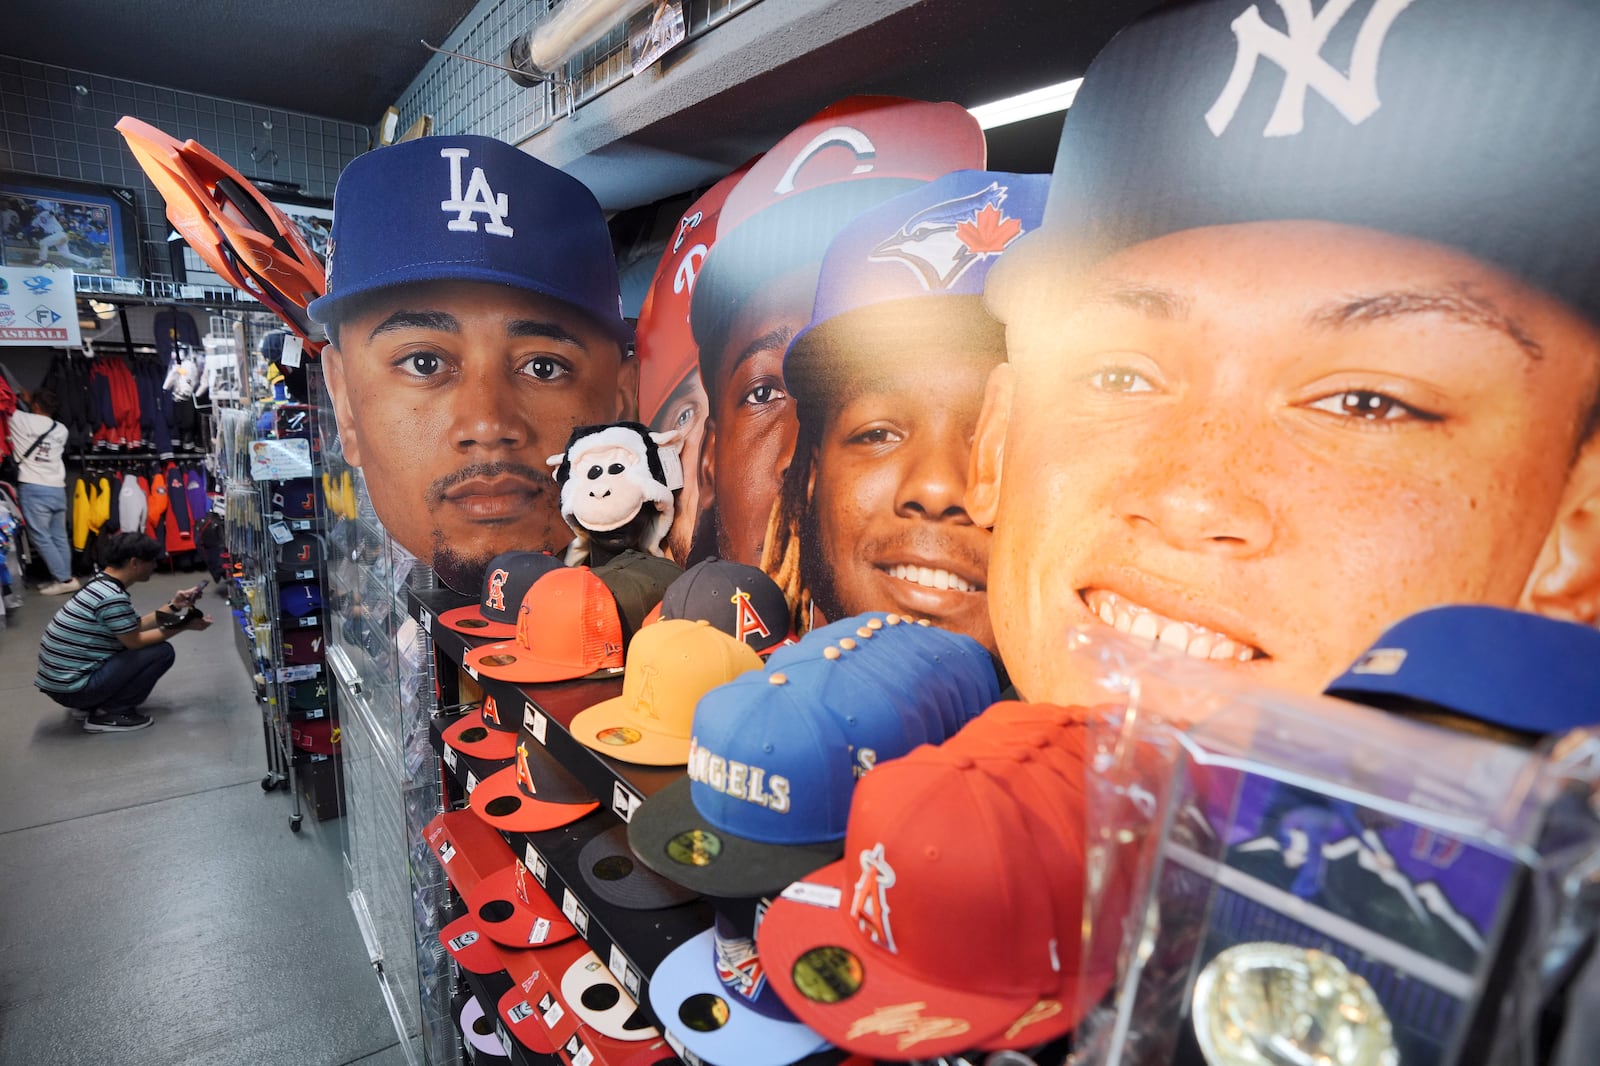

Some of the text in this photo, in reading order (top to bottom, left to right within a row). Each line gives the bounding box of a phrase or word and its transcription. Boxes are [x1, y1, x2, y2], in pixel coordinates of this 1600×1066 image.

[1204, 0, 1412, 137] NY
[440, 148, 514, 238] LA
[730, 586, 771, 644] A
[483, 694, 501, 725] A
[516, 741, 537, 794] A
[850, 842, 898, 955] A
